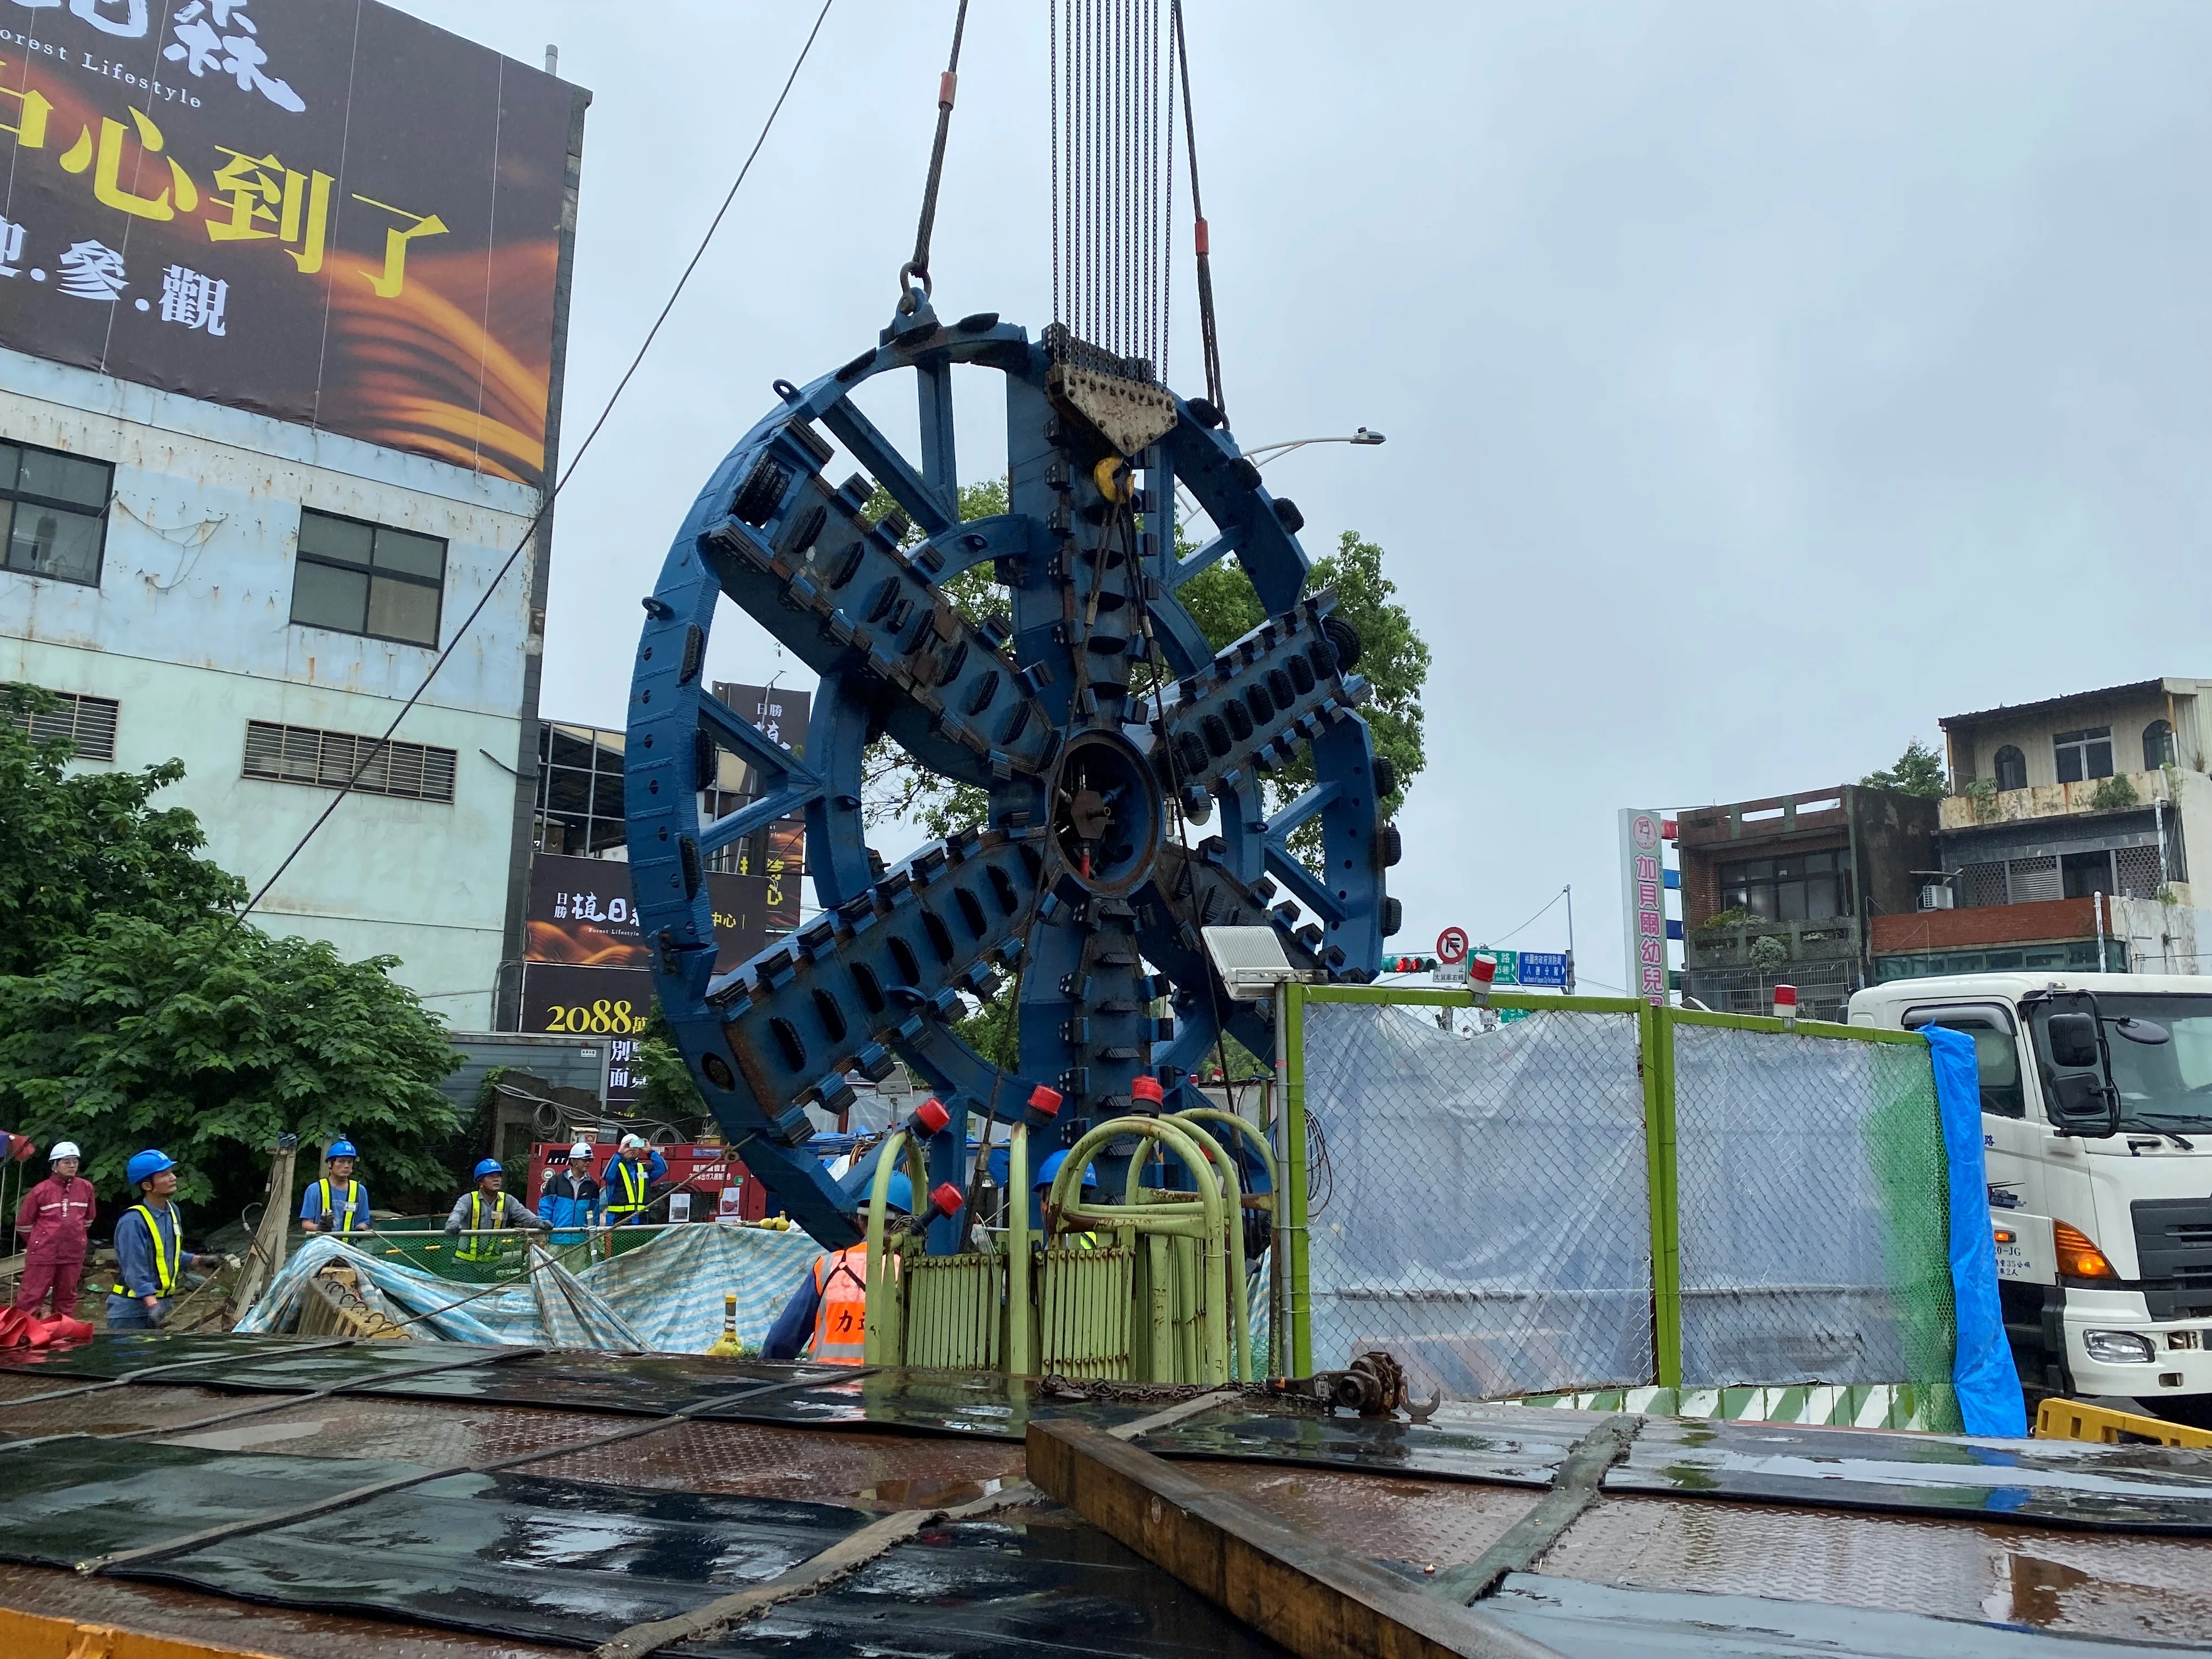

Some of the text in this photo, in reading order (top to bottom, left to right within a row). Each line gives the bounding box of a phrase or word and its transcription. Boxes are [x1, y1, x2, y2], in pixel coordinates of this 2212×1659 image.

[82, 53, 201, 108] Lifestyle
[554, 892, 567, 918] 日勝
[572, 891, 640, 927] 植日
[712, 912, 736, 928] 中心
